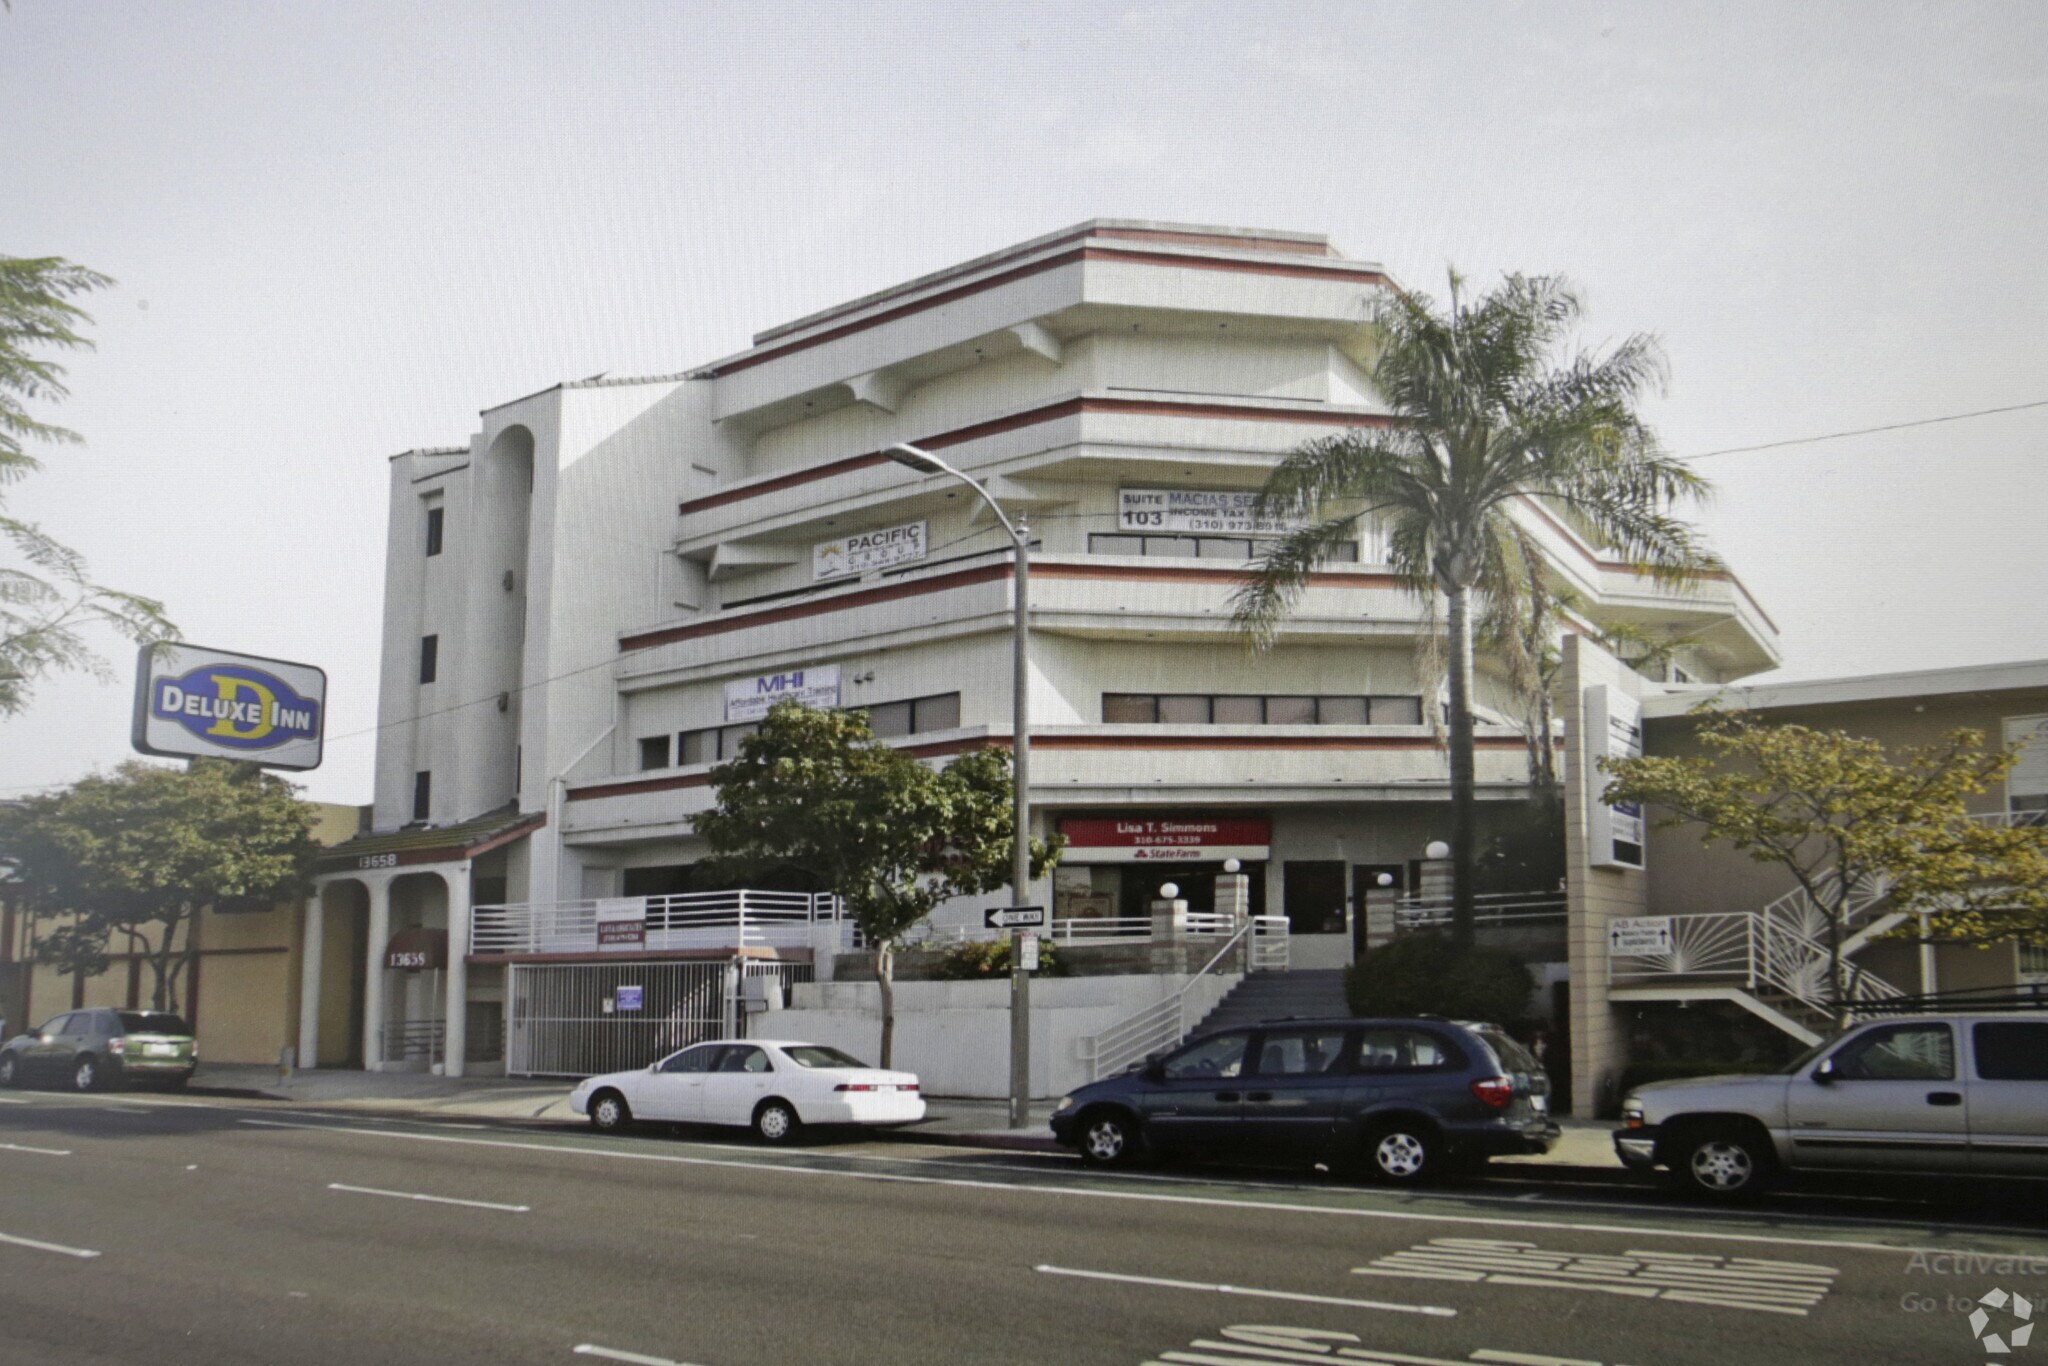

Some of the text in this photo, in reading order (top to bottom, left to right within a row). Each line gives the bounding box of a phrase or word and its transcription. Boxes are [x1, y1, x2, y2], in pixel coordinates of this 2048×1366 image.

[1123, 494, 1163, 505] SUITE
[1169, 492, 1228, 507] MACIAS
[1124, 511, 1163, 526] 103
[1169, 508, 1218, 517] INCOME
[1222, 510, 1245, 518] TAX
[848, 525, 920, 551] PACIFIC
[757, 671, 804, 693] MHI
[161, 685, 310, 730] DELUXE INN
[1117, 822, 1217, 833] Lisa T. Simmons
[358, 853, 397, 868] 13658
